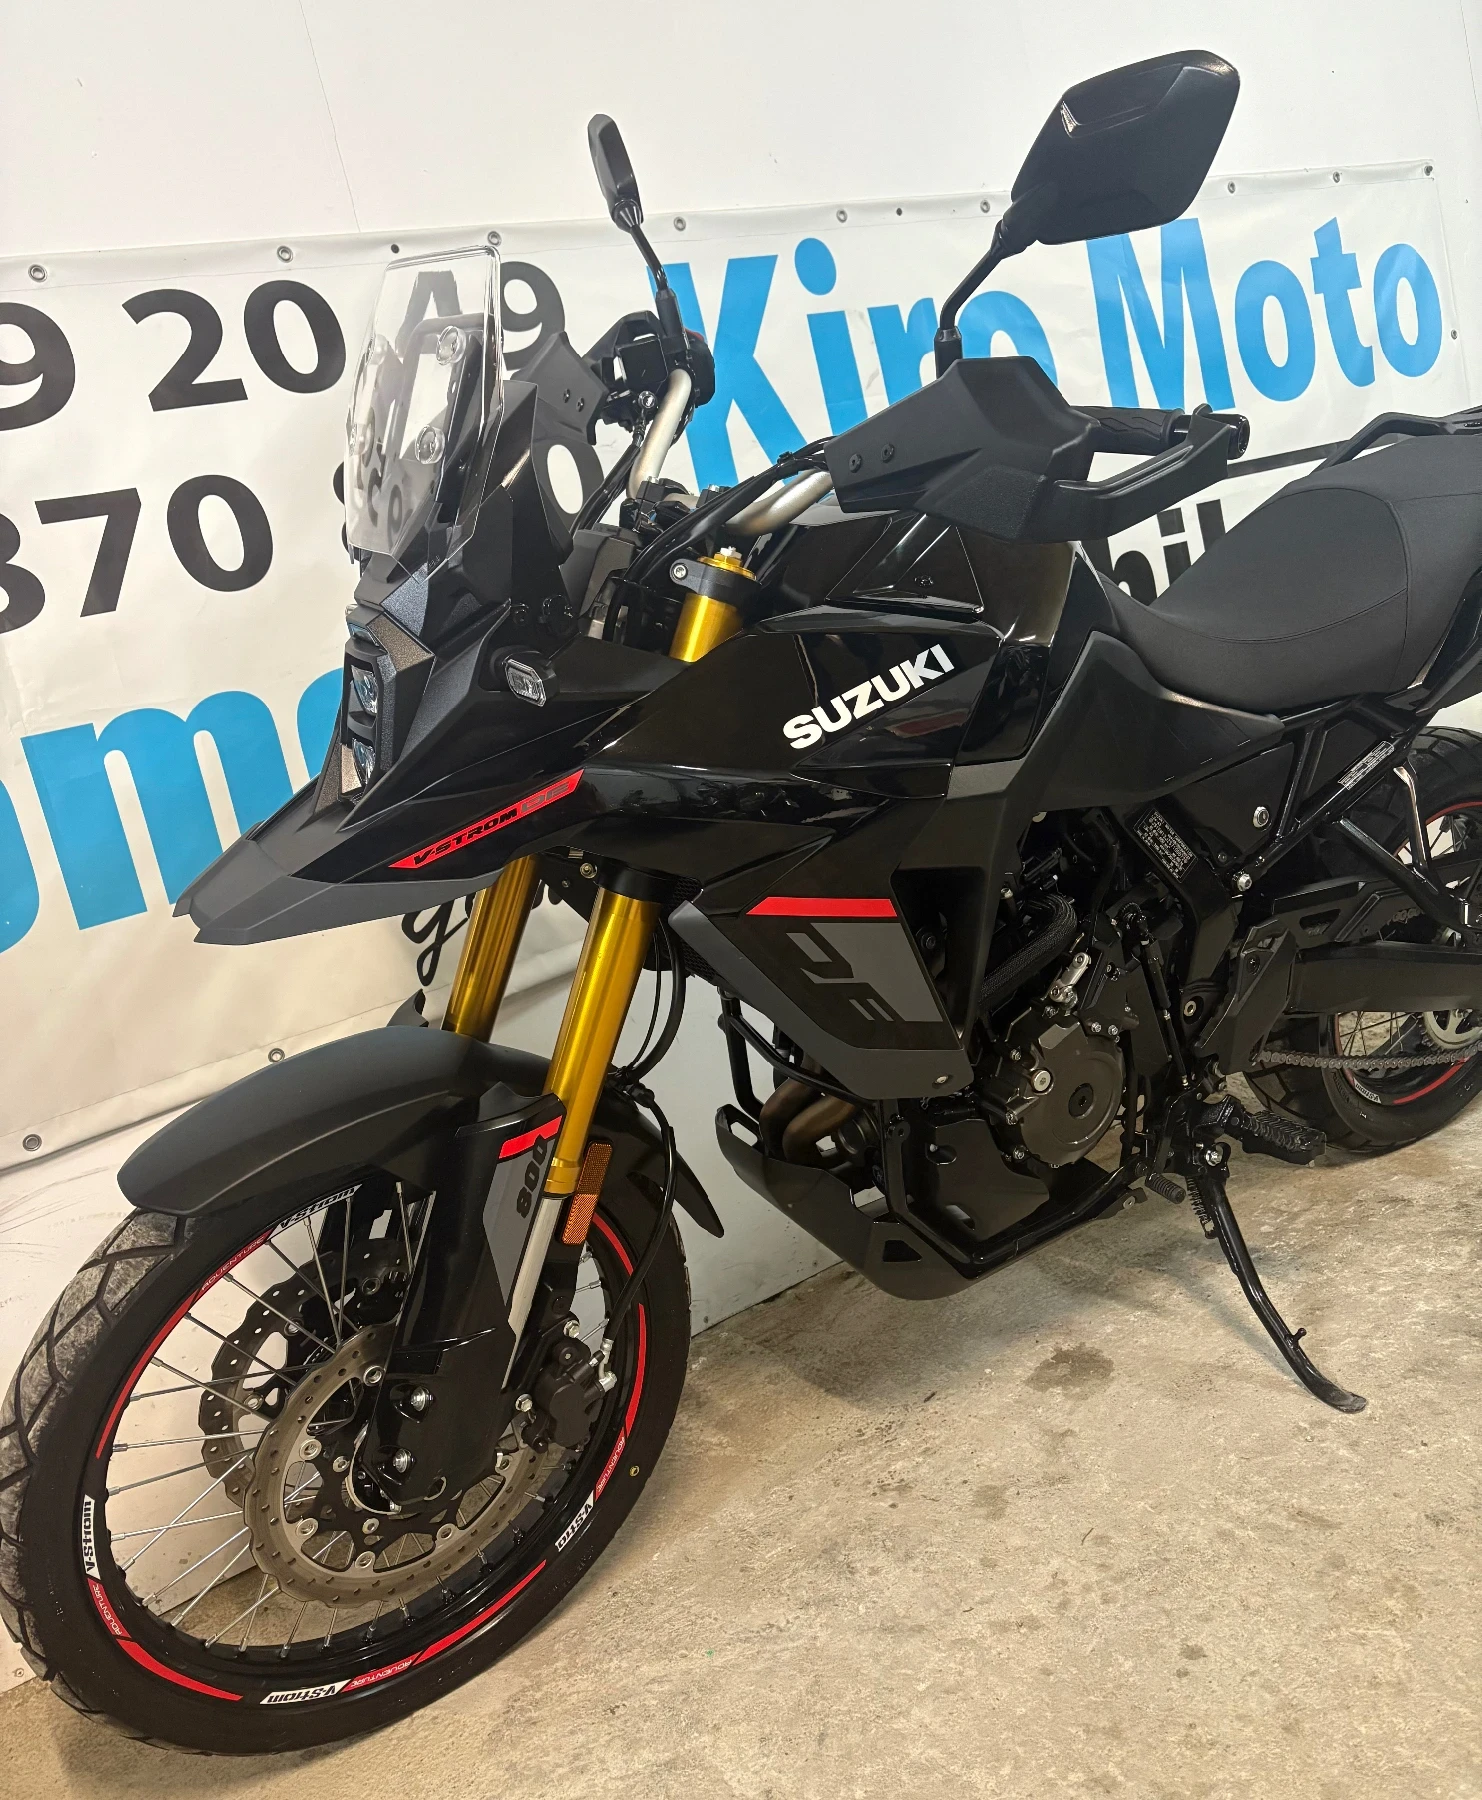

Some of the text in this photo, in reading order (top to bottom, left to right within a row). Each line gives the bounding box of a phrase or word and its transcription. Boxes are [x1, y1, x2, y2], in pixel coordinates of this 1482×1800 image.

[121, 279, 347, 412] 20
[1087, 217, 1443, 412] Moto
[783, 643, 955, 750] SUZUKI
[413, 807, 518, 865] V-STROM
[516, 1133, 549, 1219] 800
[92, 1583, 123, 1636] ADVENTURE
